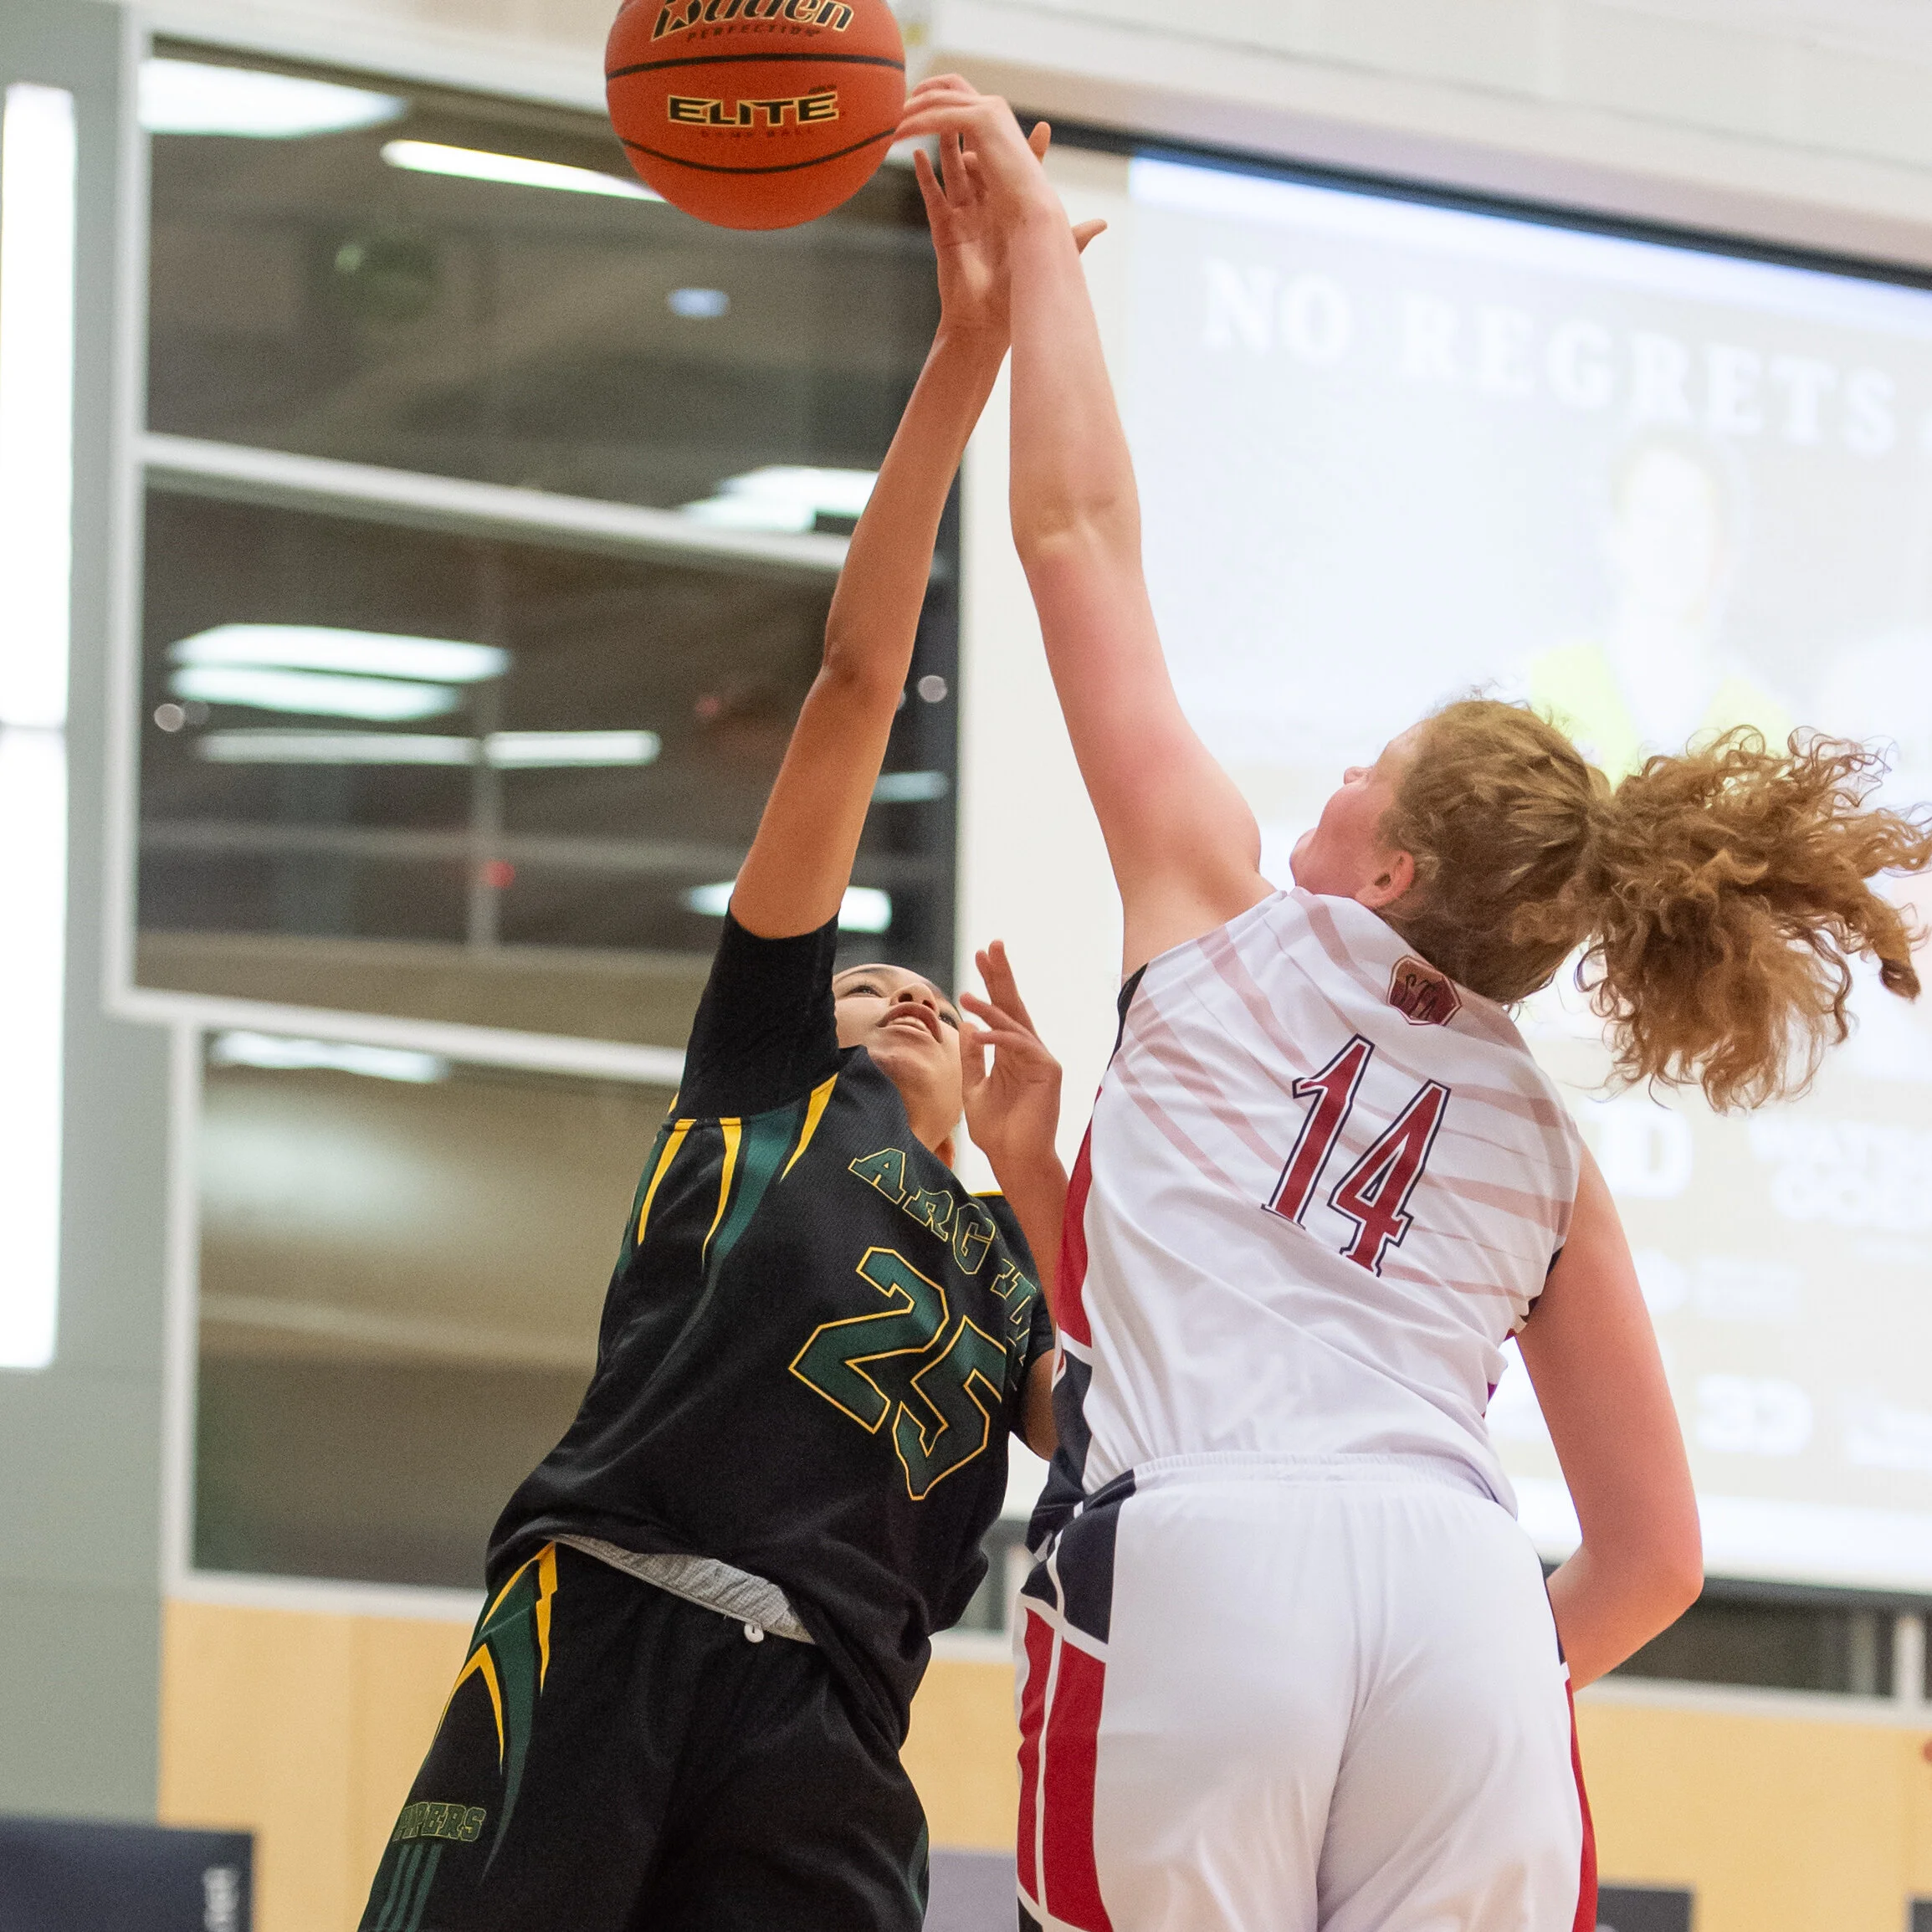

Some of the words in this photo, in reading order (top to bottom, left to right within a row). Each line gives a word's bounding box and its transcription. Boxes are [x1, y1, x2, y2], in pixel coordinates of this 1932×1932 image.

[668, 91, 839, 127] ELITE
[1202, 257, 1351, 366] NO
[1397, 294, 1897, 455] REGRETS
[1261, 1033, 1451, 1278] 14
[788, 1246, 1007, 1500] 25
